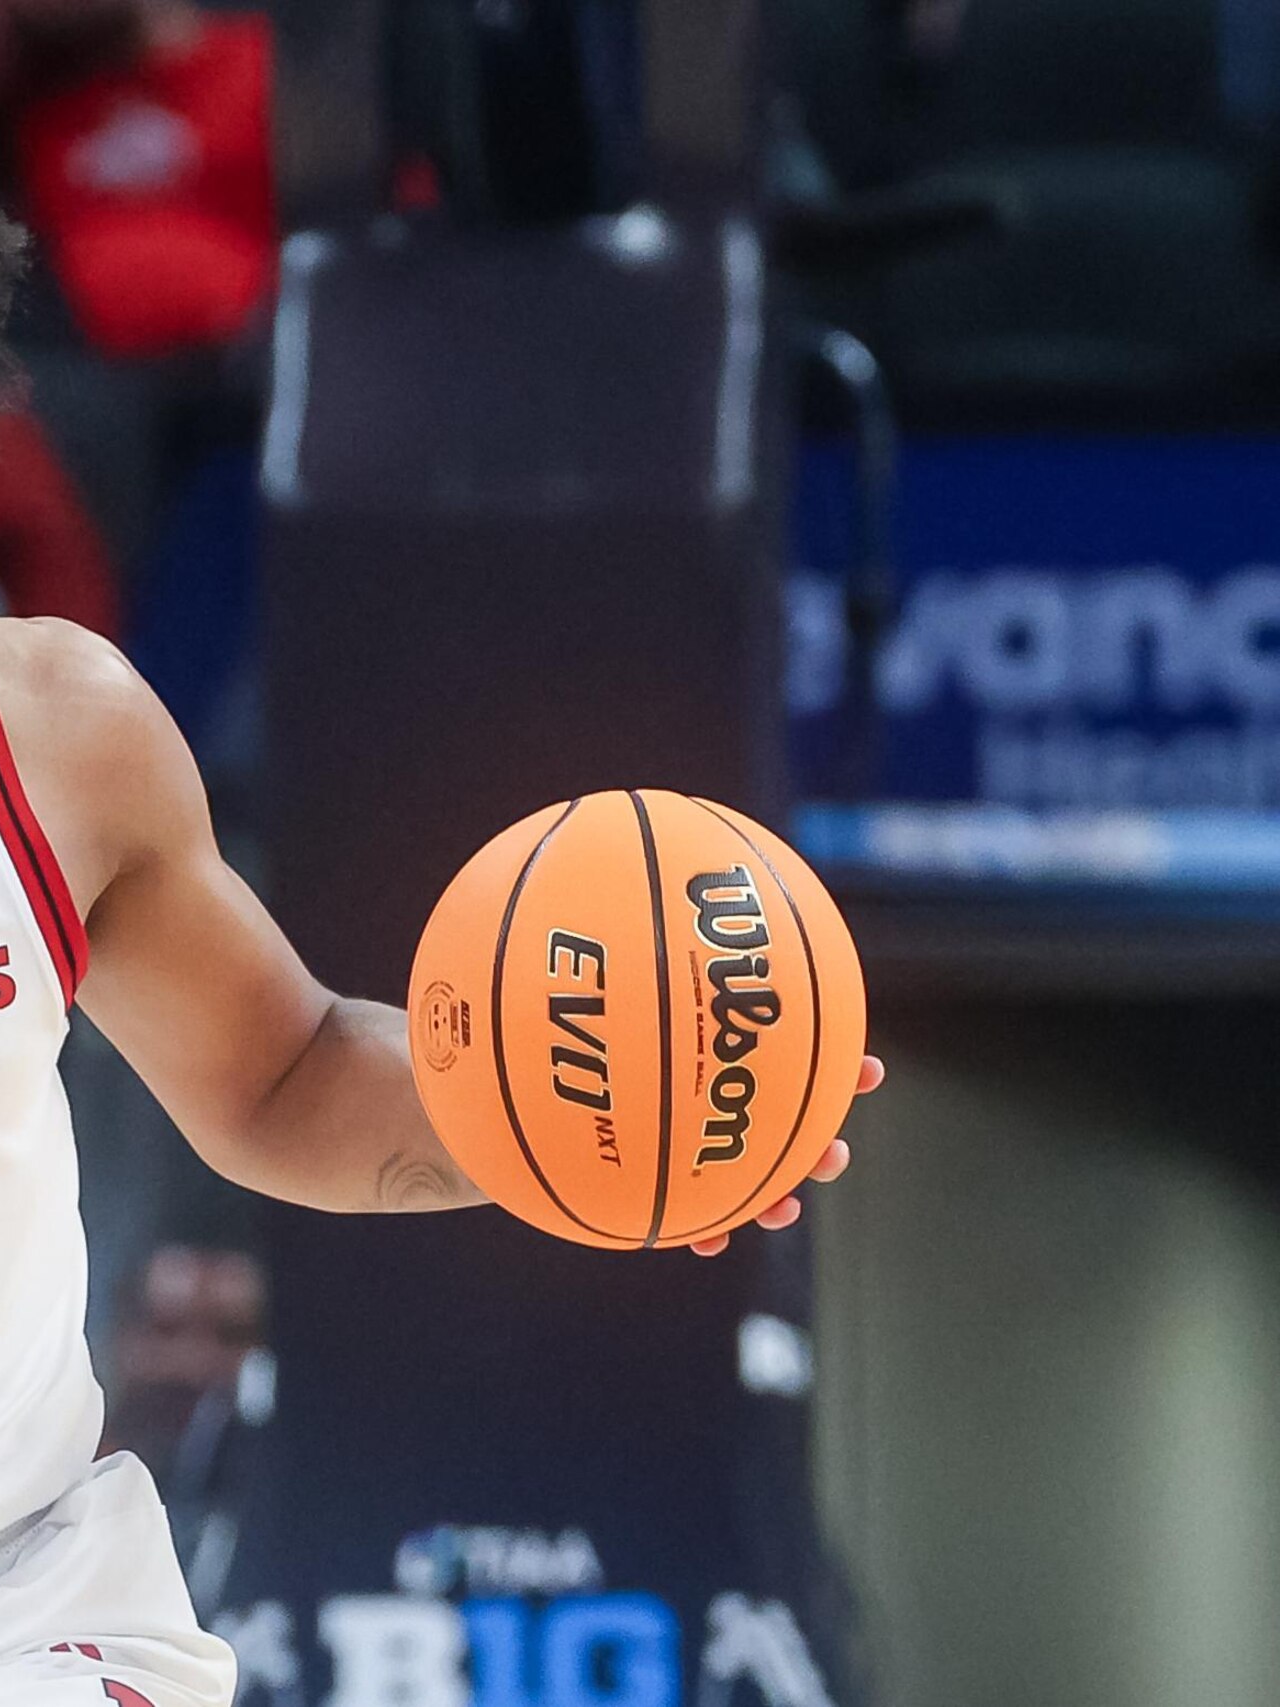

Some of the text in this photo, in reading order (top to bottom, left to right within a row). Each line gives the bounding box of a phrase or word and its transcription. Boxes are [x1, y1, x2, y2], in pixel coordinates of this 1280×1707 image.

[548, 928, 621, 1167] EVO NXT
[685, 862, 782, 1166] Wilson
